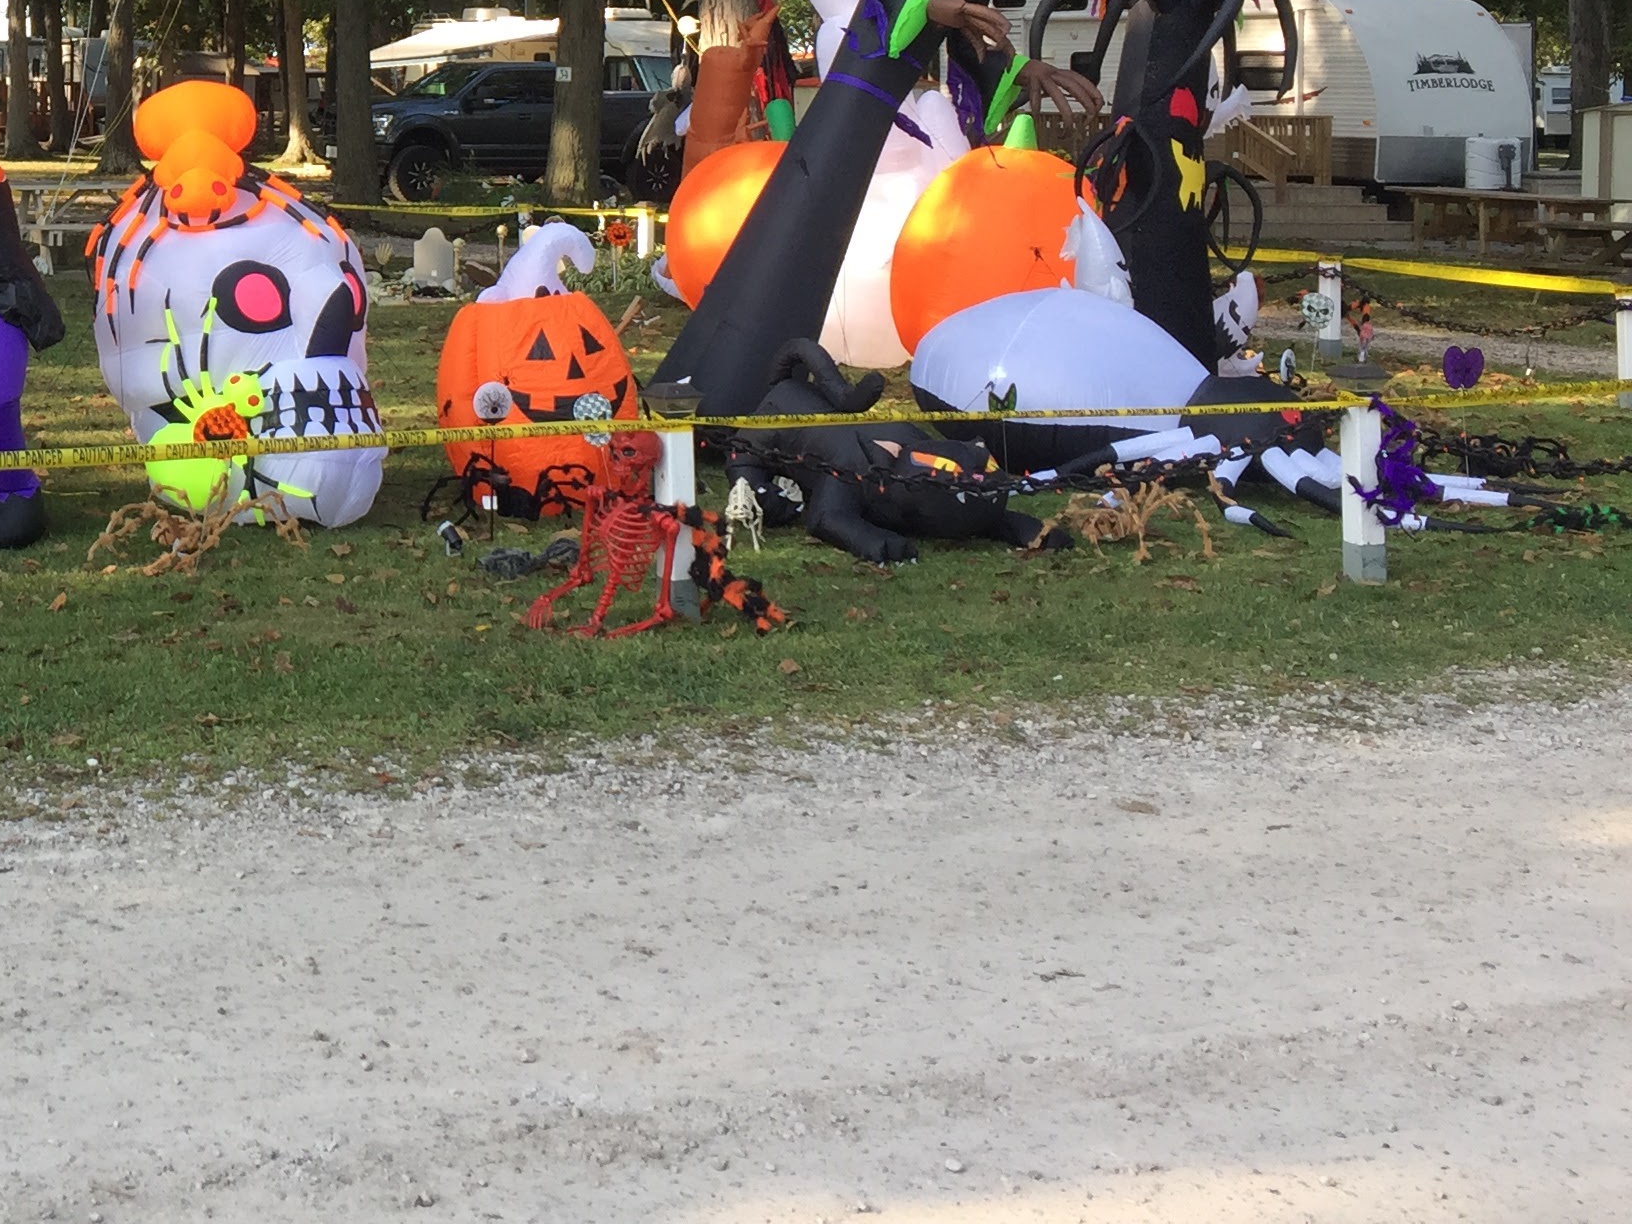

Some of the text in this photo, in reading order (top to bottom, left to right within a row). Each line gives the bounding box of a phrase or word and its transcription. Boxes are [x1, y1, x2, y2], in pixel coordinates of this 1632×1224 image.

[1407, 77, 1495, 92] TIMBERLODGE
[72, 445, 157, 464] CAUTION-DANGER
[166, 441, 249, 458] CAUTION-DANGER
[258, 437, 339, 453] CAUTION-DANGER
[348, 431, 427, 447] CAUTION-DANGER
[436, 427, 514, 443] CAUTION-DANGER
